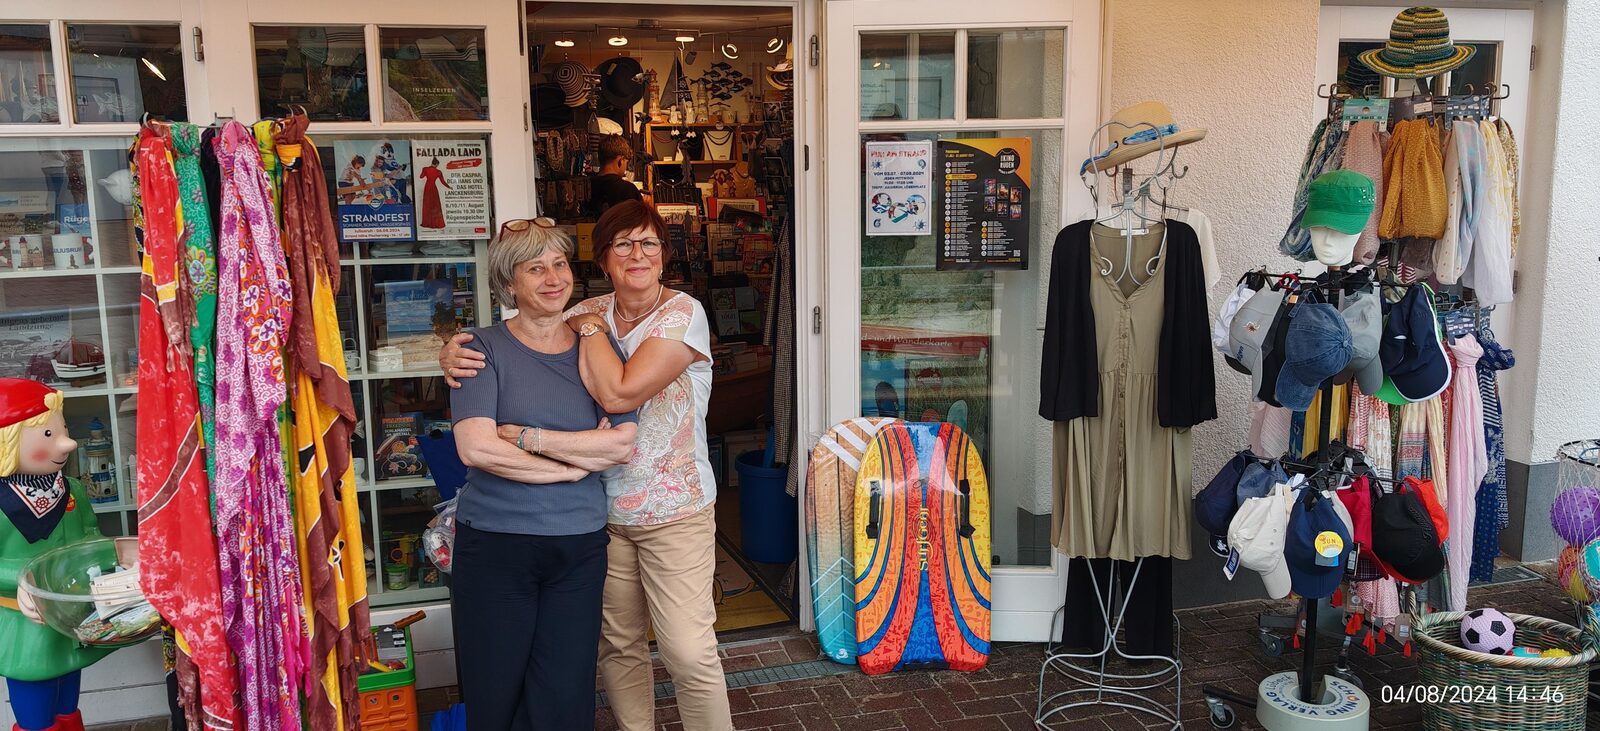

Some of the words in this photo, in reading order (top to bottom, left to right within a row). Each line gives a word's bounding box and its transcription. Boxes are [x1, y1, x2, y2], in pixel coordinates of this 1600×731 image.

[416, 148, 456, 157] FALLADA
[458, 148, 482, 157] LAND
[342, 213, 411, 223] STRANDFEST
[1266, 691, 1319, 716] VERLAG
